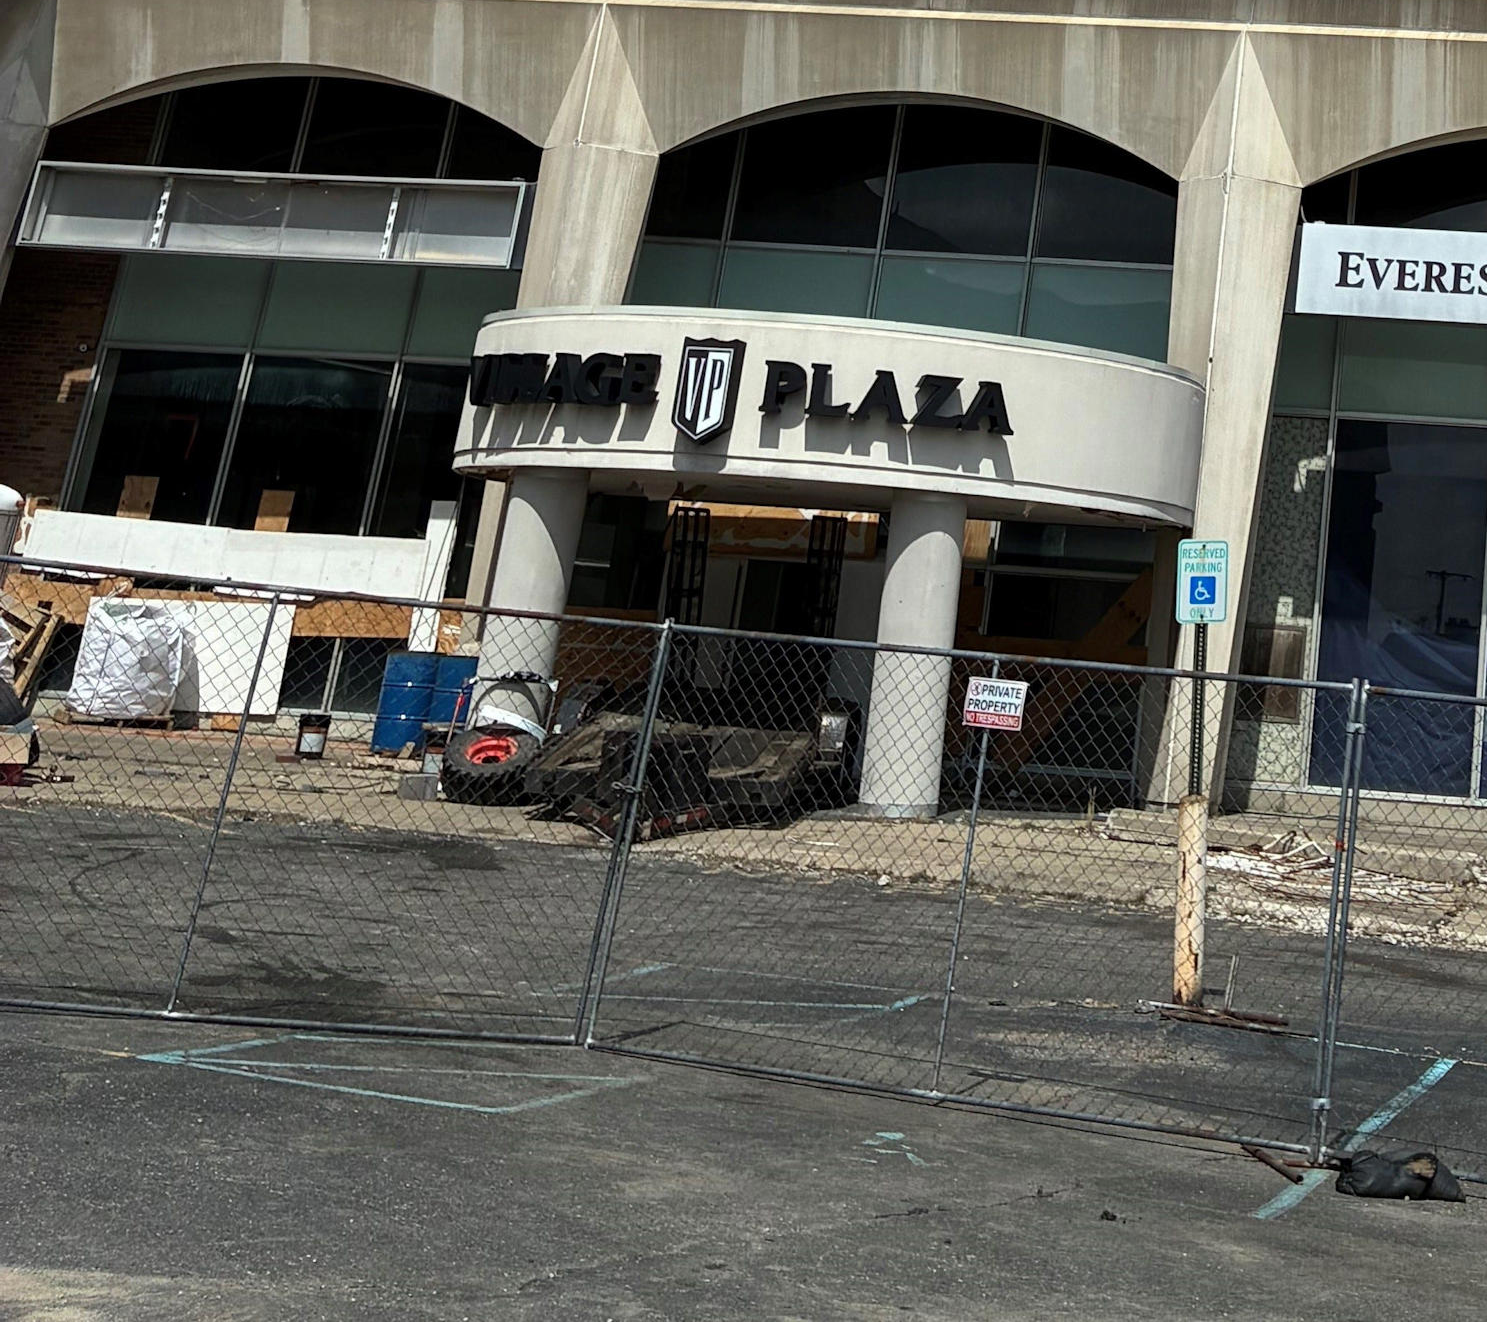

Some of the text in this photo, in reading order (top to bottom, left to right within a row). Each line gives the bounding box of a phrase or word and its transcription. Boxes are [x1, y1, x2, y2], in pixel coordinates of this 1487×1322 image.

[758, 359, 1014, 436] PLAZA
[1182, 548, 1226, 559] RESERVED
[1184, 562, 1223, 573] PARKING
[1189, 607, 1215, 619] ONLY
[981, 684, 1023, 700] PRIVATE
[967, 698, 1021, 714] PROPERTY
[966, 712, 1019, 727] NO TRESPASSING
